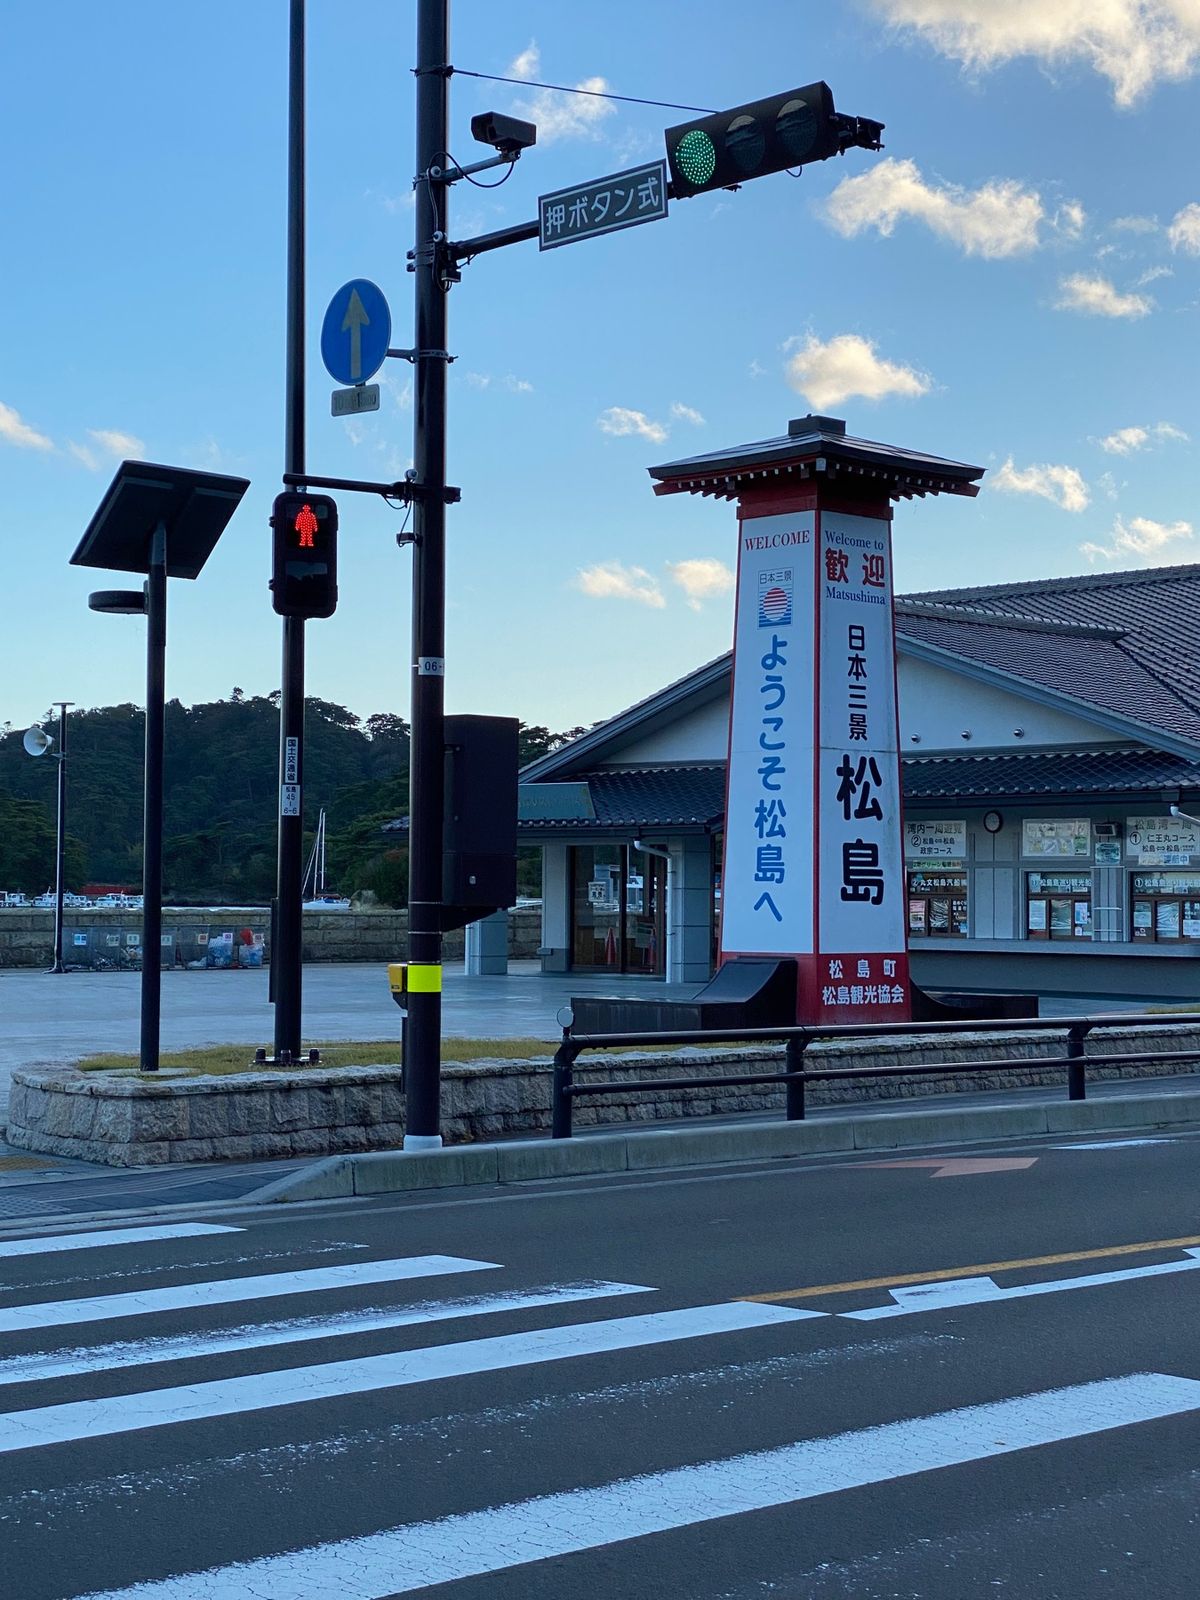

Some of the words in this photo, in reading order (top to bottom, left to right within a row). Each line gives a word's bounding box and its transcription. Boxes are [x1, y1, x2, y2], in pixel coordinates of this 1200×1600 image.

[545, 176, 660, 236] 押ボタン式
[744, 529, 811, 551] WELCOME
[824, 529, 871, 550] Welcome
[873, 537, 885, 551] to
[759, 570, 793, 585] 日本三景
[825, 585, 887, 606] Matsushima
[847, 624, 868, 742] 日本三景
[286, 738, 297, 782] 国土交通省
[753, 633, 789, 923] ようこそ松島へ
[286, 793, 296, 801] 45
[835, 752, 885, 906] 松島
[1146, 833, 1197, 844] 仁王丸コース
[828, 958, 898, 980] 松島町
[821, 983, 905, 1006] 松島観光協会
